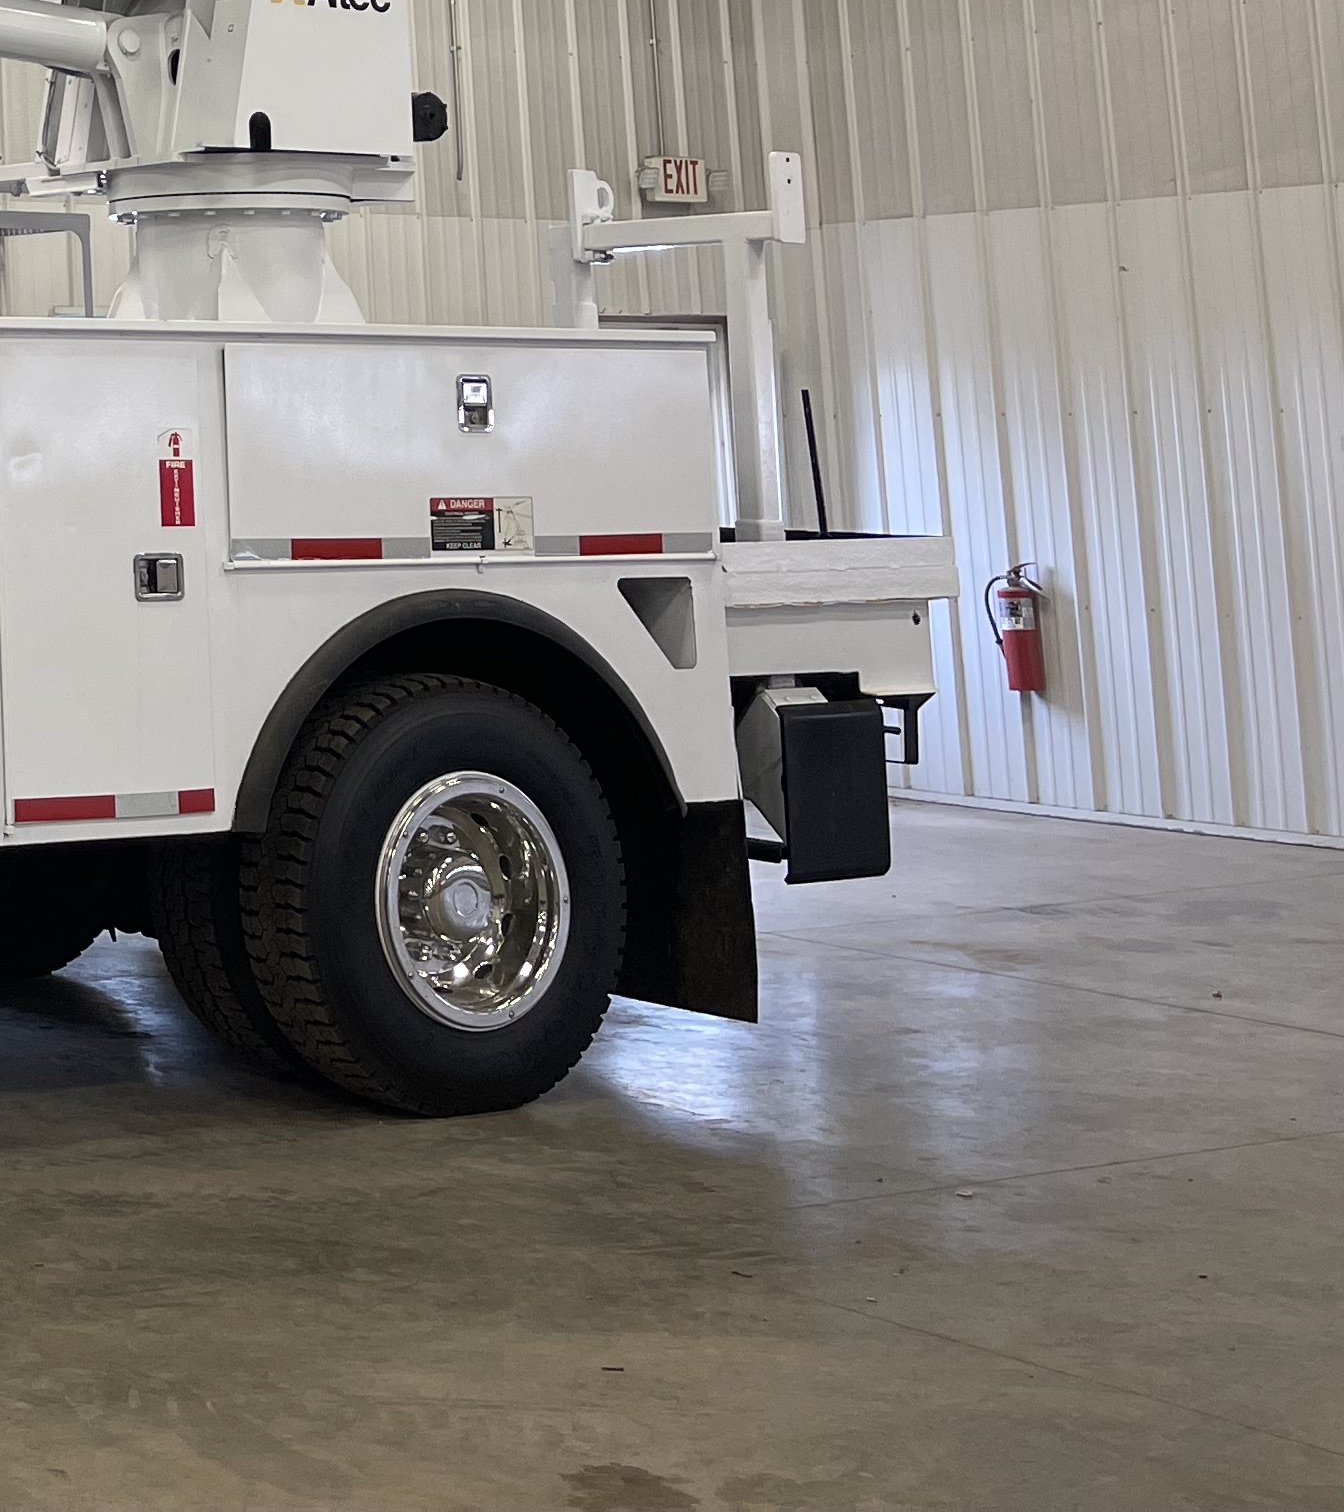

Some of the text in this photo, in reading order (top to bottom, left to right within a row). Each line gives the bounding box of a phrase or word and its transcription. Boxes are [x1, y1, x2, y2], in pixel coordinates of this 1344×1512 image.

[662, 158, 699, 196] EXIT
[165, 460, 187, 469] FIRE
[449, 499, 486, 509] DANGER
